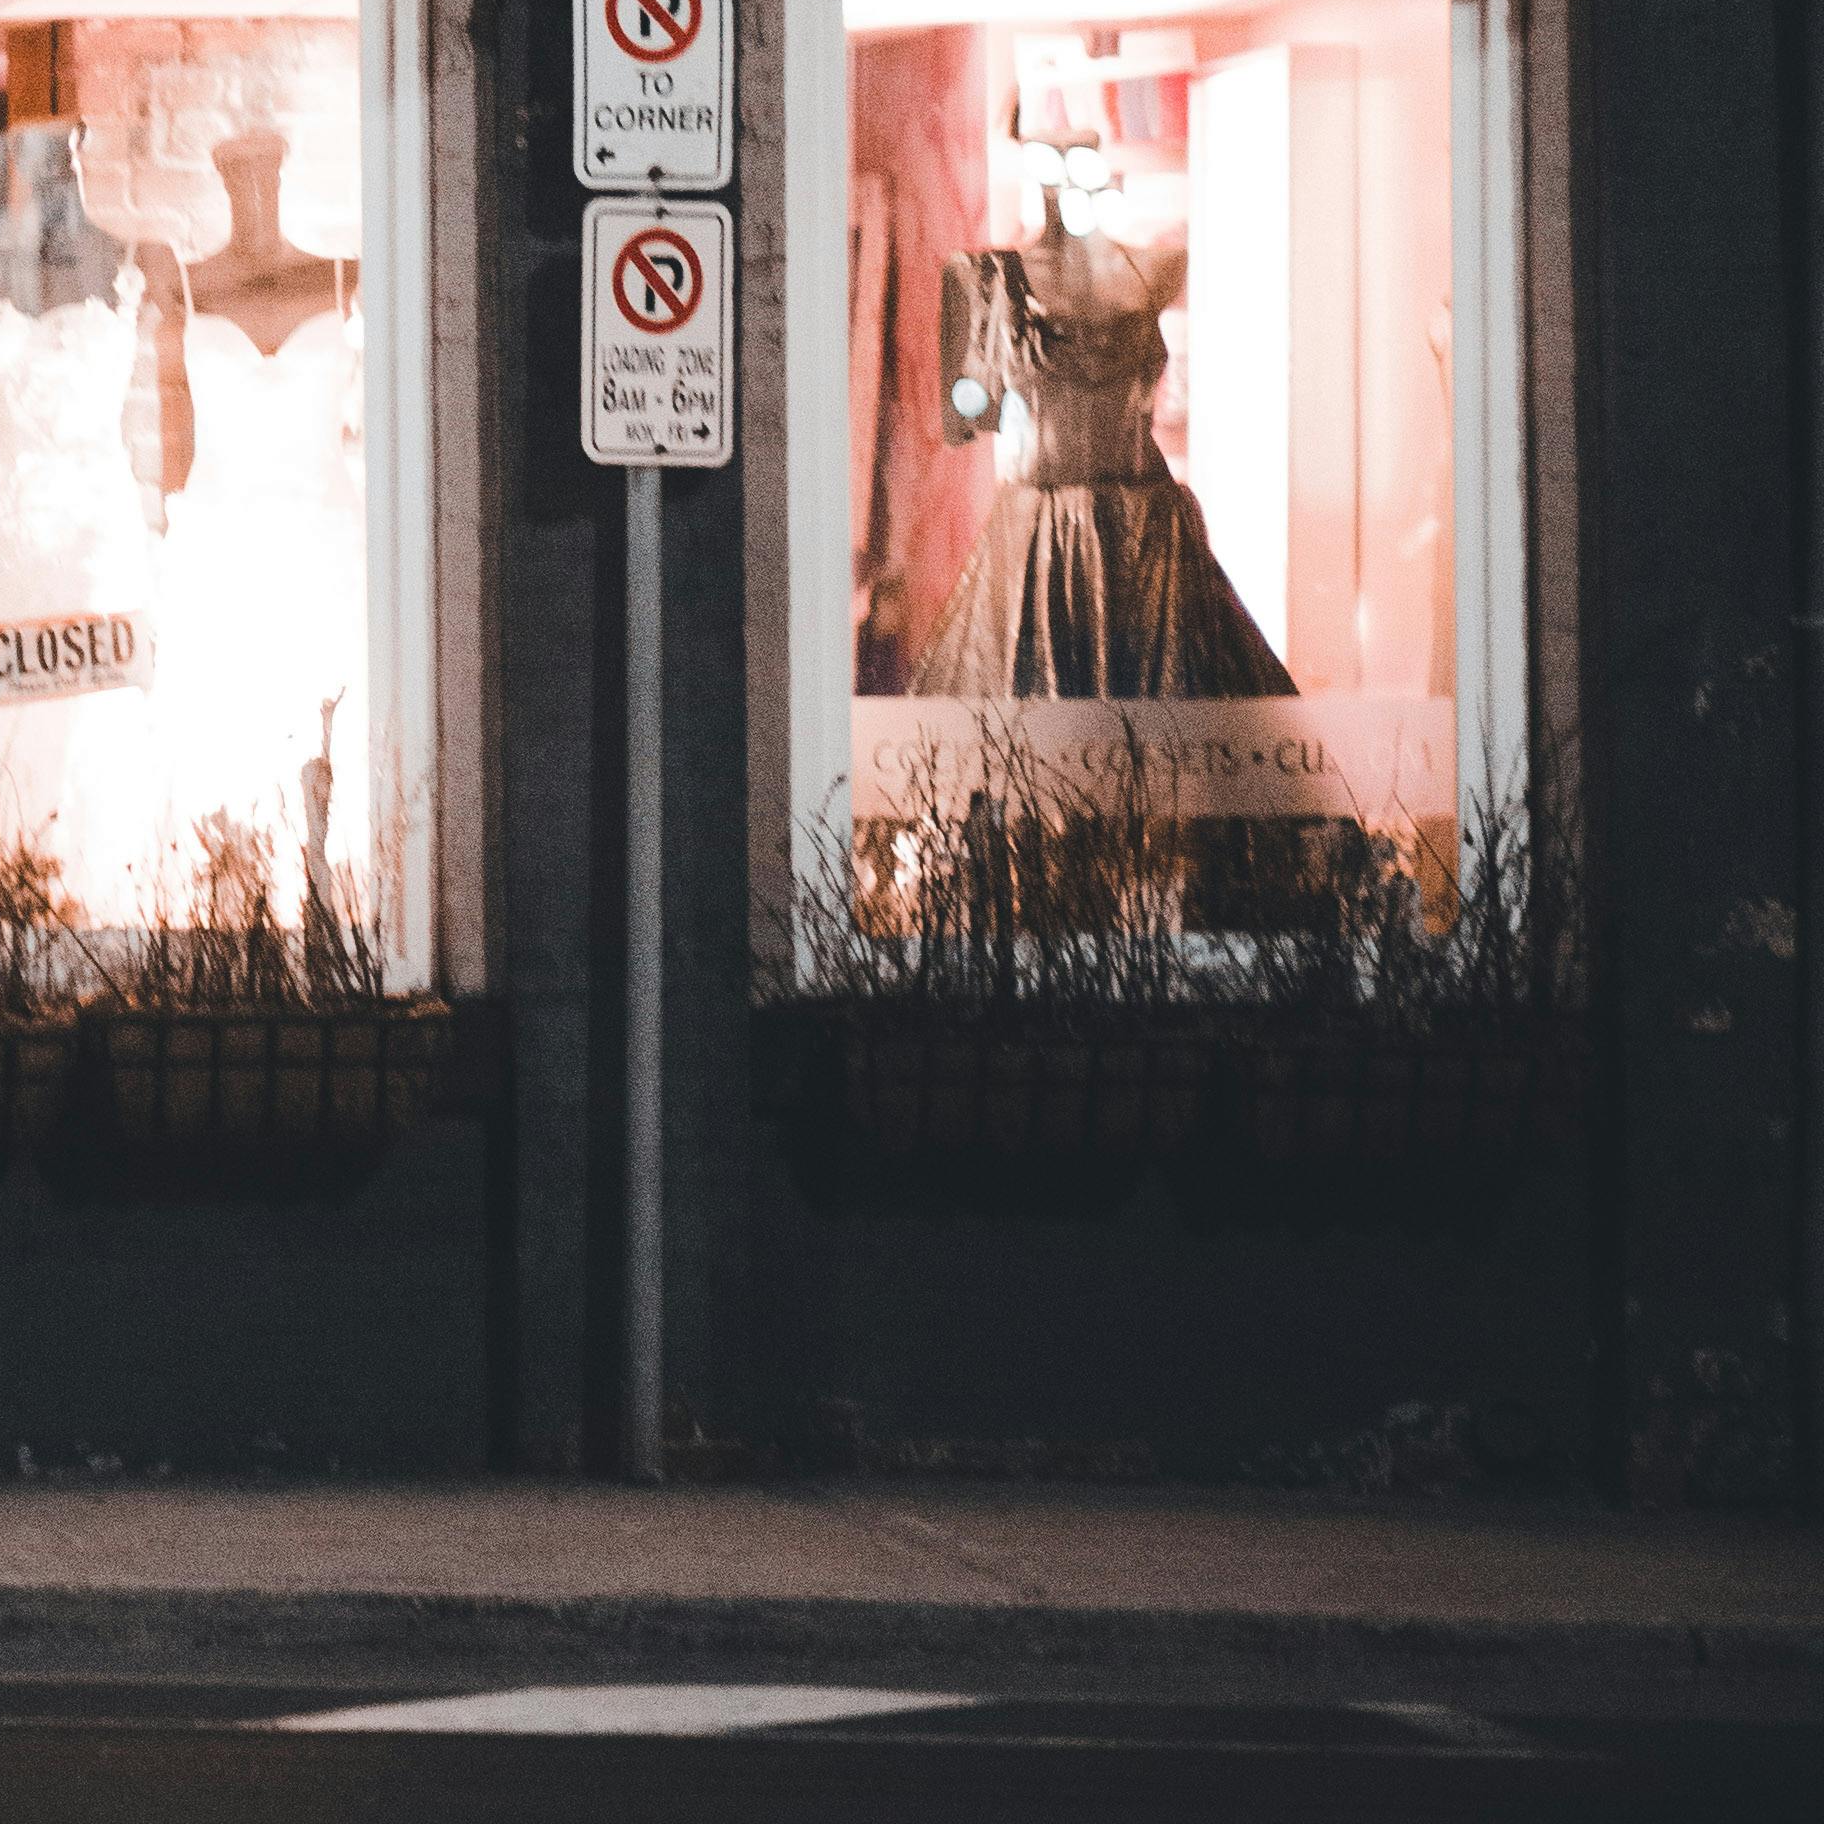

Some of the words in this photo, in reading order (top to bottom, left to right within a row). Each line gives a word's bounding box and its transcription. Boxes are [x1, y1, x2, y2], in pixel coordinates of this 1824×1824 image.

[639, 70, 675, 97] TO
[593, 104, 714, 133] CORNER
[601, 344, 665, 375] LOADING
[677, 346, 714, 376] ZONE
[1080, 739, 1240, 776] COETS
